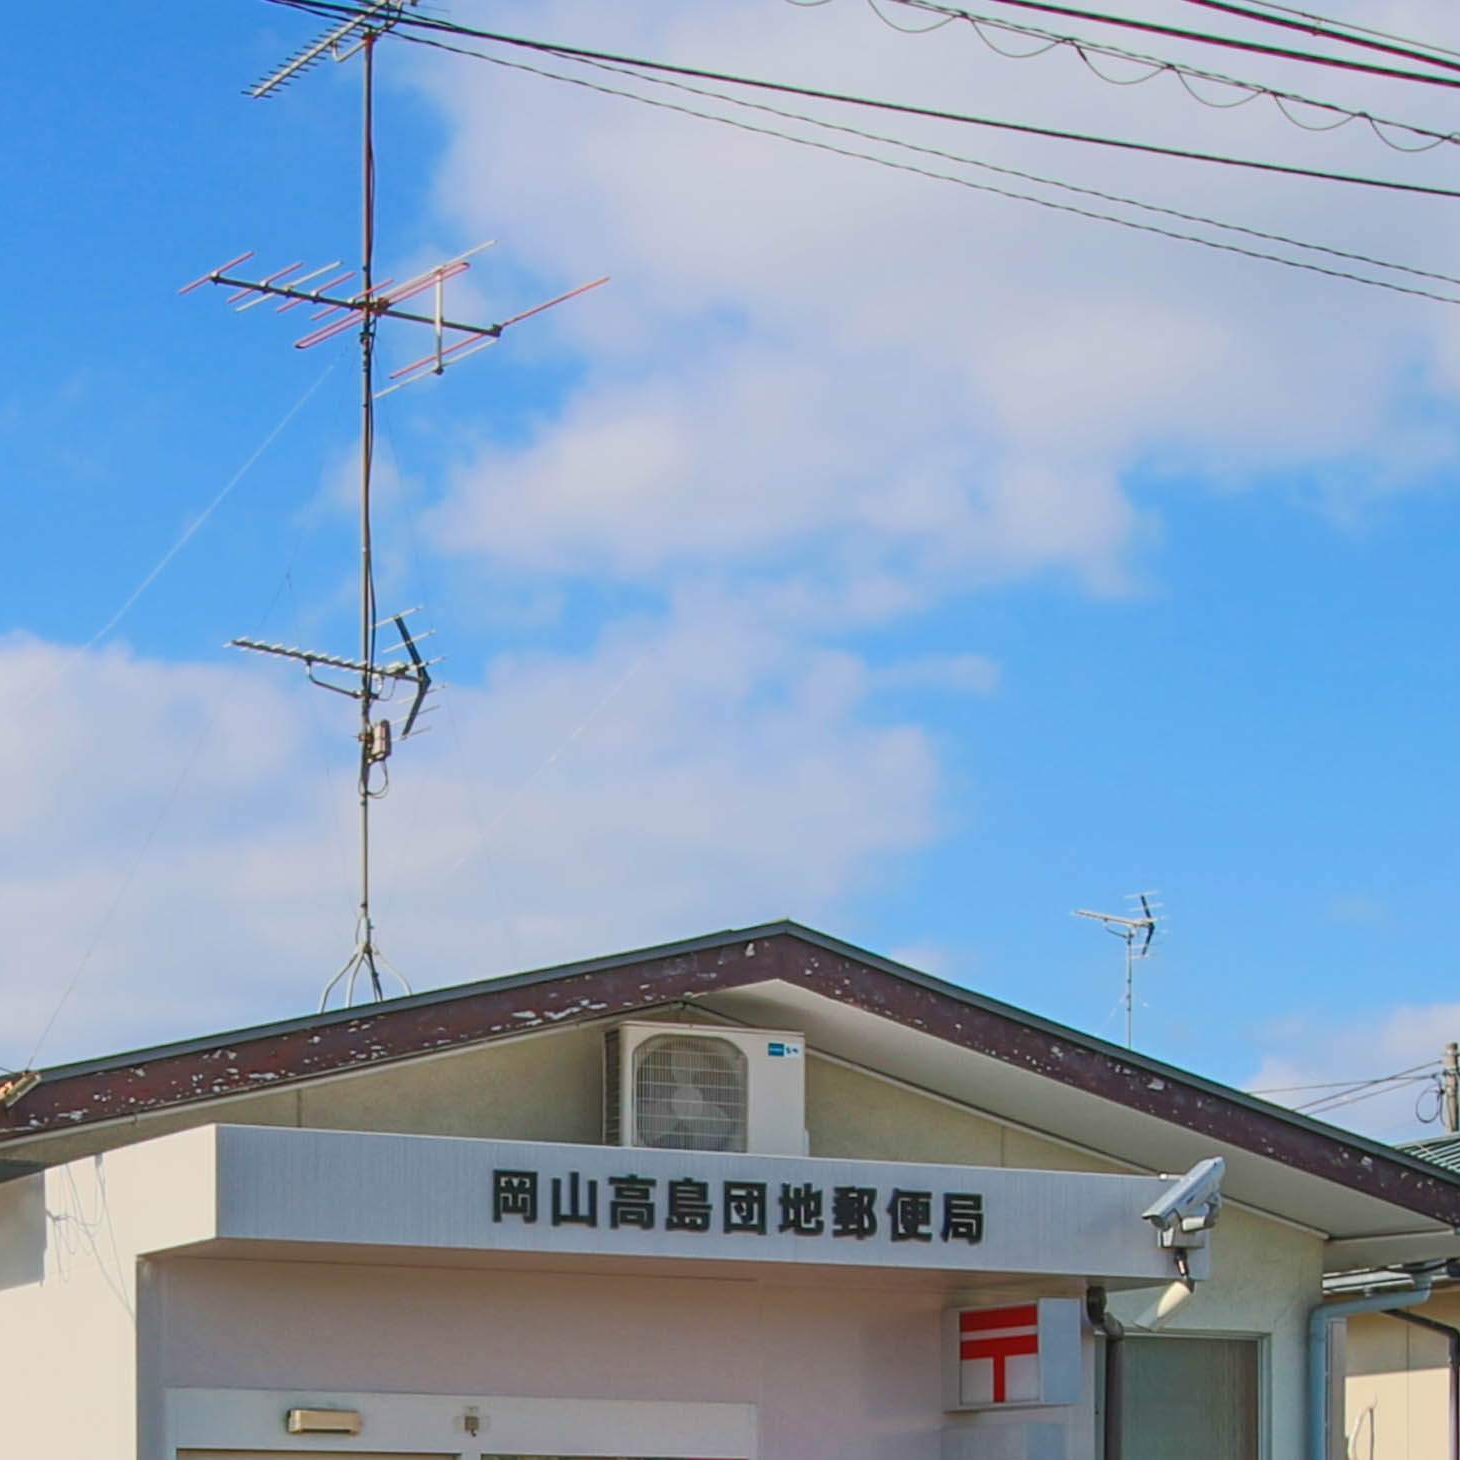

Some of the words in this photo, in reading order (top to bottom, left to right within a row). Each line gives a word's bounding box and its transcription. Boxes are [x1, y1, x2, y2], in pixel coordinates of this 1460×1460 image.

[492, 1168, 984, 1244] 岡山高島団地郵便局
